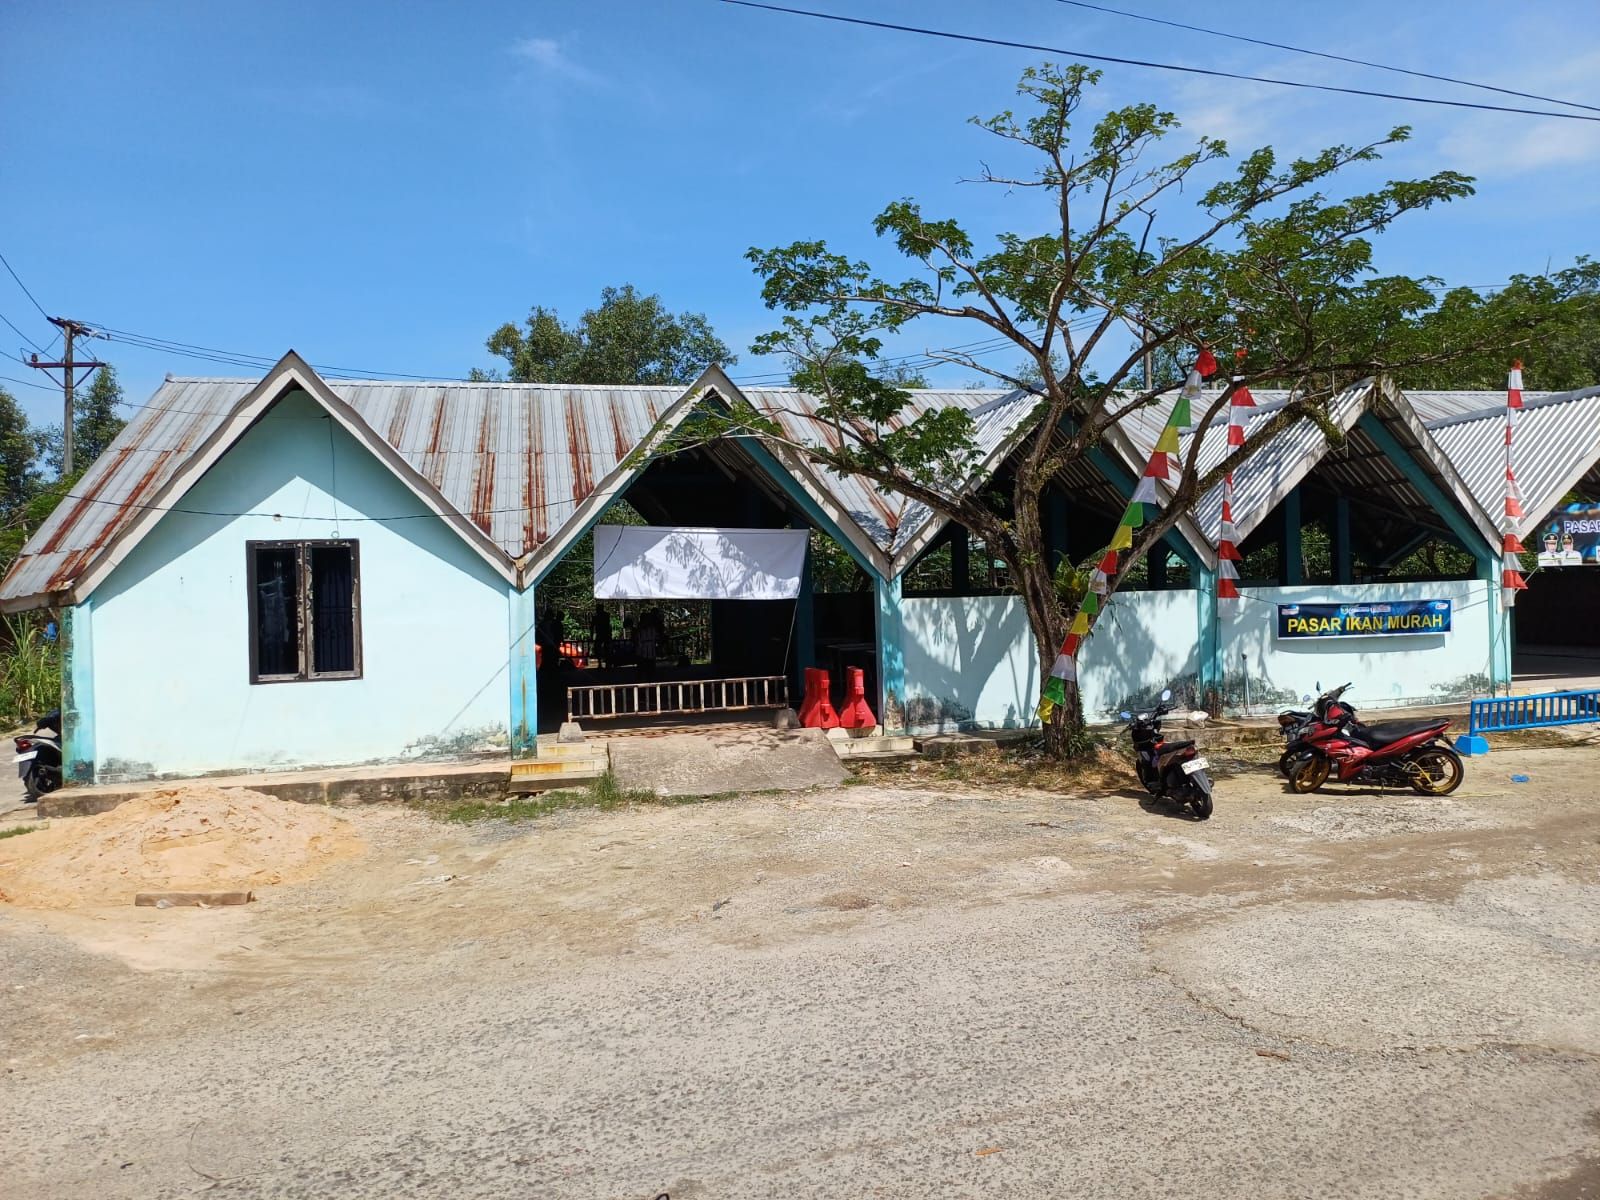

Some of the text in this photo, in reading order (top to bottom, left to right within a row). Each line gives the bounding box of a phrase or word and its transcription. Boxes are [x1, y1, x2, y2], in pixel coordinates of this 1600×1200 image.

[1287, 614, 1443, 633] PASAR IKAN MURAH
